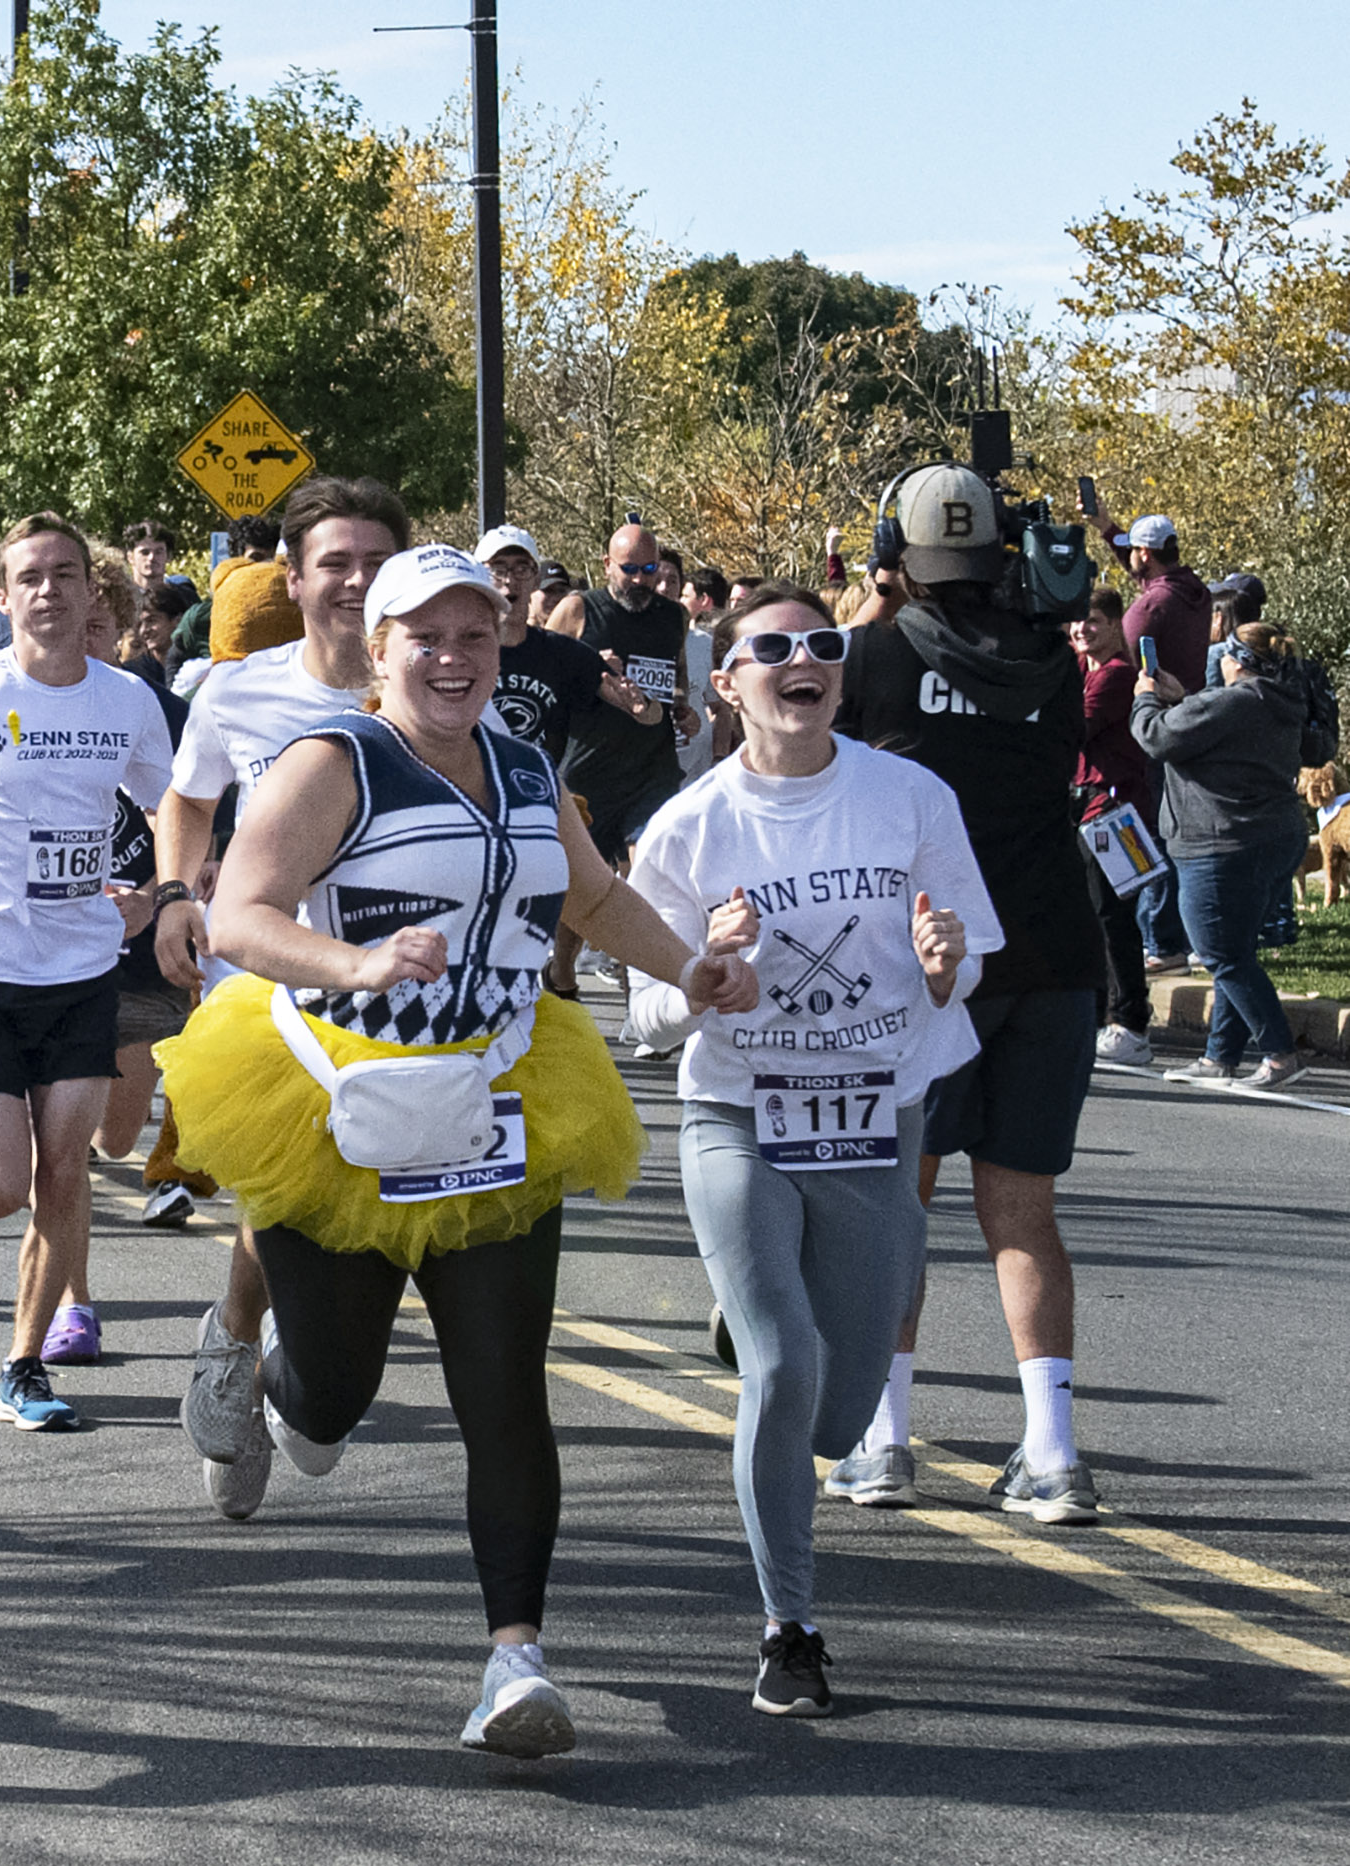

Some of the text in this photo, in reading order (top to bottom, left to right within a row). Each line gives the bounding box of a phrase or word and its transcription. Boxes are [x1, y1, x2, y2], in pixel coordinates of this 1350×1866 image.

[222, 421, 270, 437] SHARE
[232, 473, 258, 489] THE
[224, 493, 265, 508] ROAD
[942, 501, 973, 537] B
[637, 668, 674, 689] 2096
[508, 673, 558, 708] STATE
[77, 731, 129, 748] STATE
[17, 750, 47, 761] CLUB
[49, 750, 65, 760] XC
[52, 831, 89, 842] THON
[110, 833, 149, 874] QUET
[809, 866, 909, 904] STATE
[342, 898, 438, 924] NITTANY LIONS
[733, 1006, 909, 1051] CLUB CROQUET
[784, 1074, 866, 1089] THON 5K
[802, 1093, 881, 1132] 117
[835, 1140, 876, 1157] PNC
[462, 1168, 503, 1186] PNC
